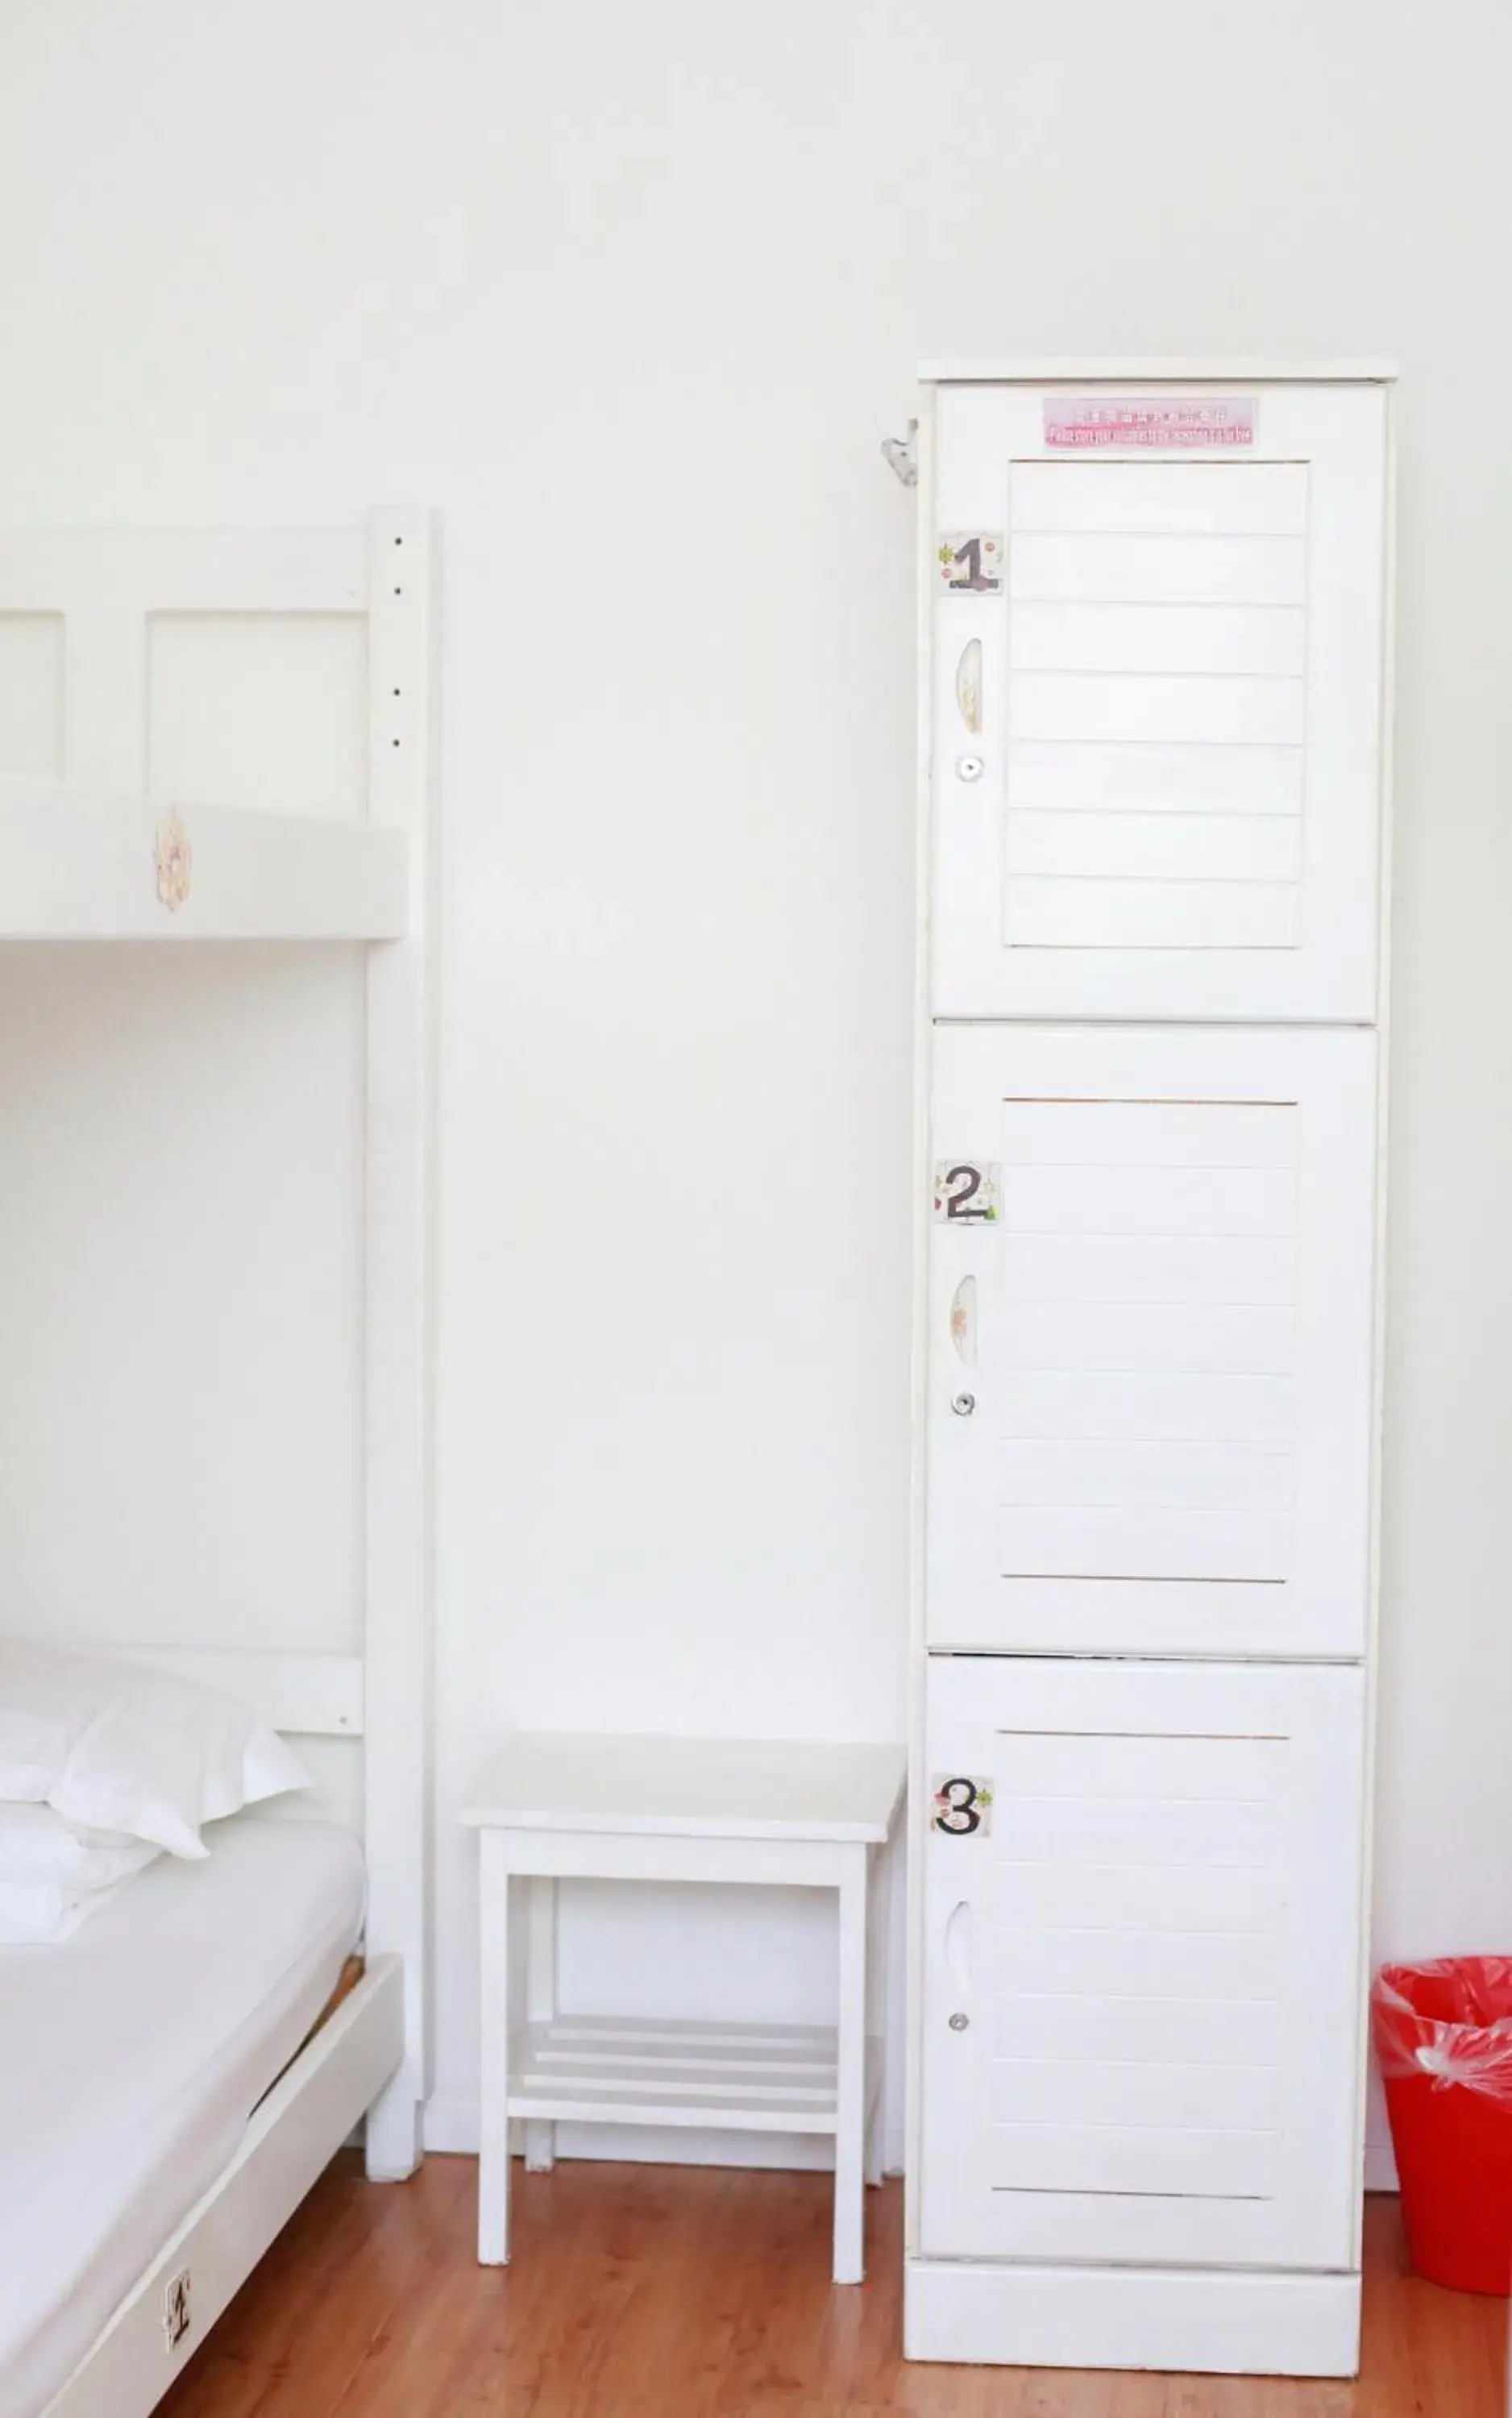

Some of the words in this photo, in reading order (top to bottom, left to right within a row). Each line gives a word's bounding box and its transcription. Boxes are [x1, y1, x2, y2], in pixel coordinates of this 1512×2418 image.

[949, 538, 999, 589] 1
[945, 1165, 991, 1218] 2
[936, 1778, 981, 1835] 3
